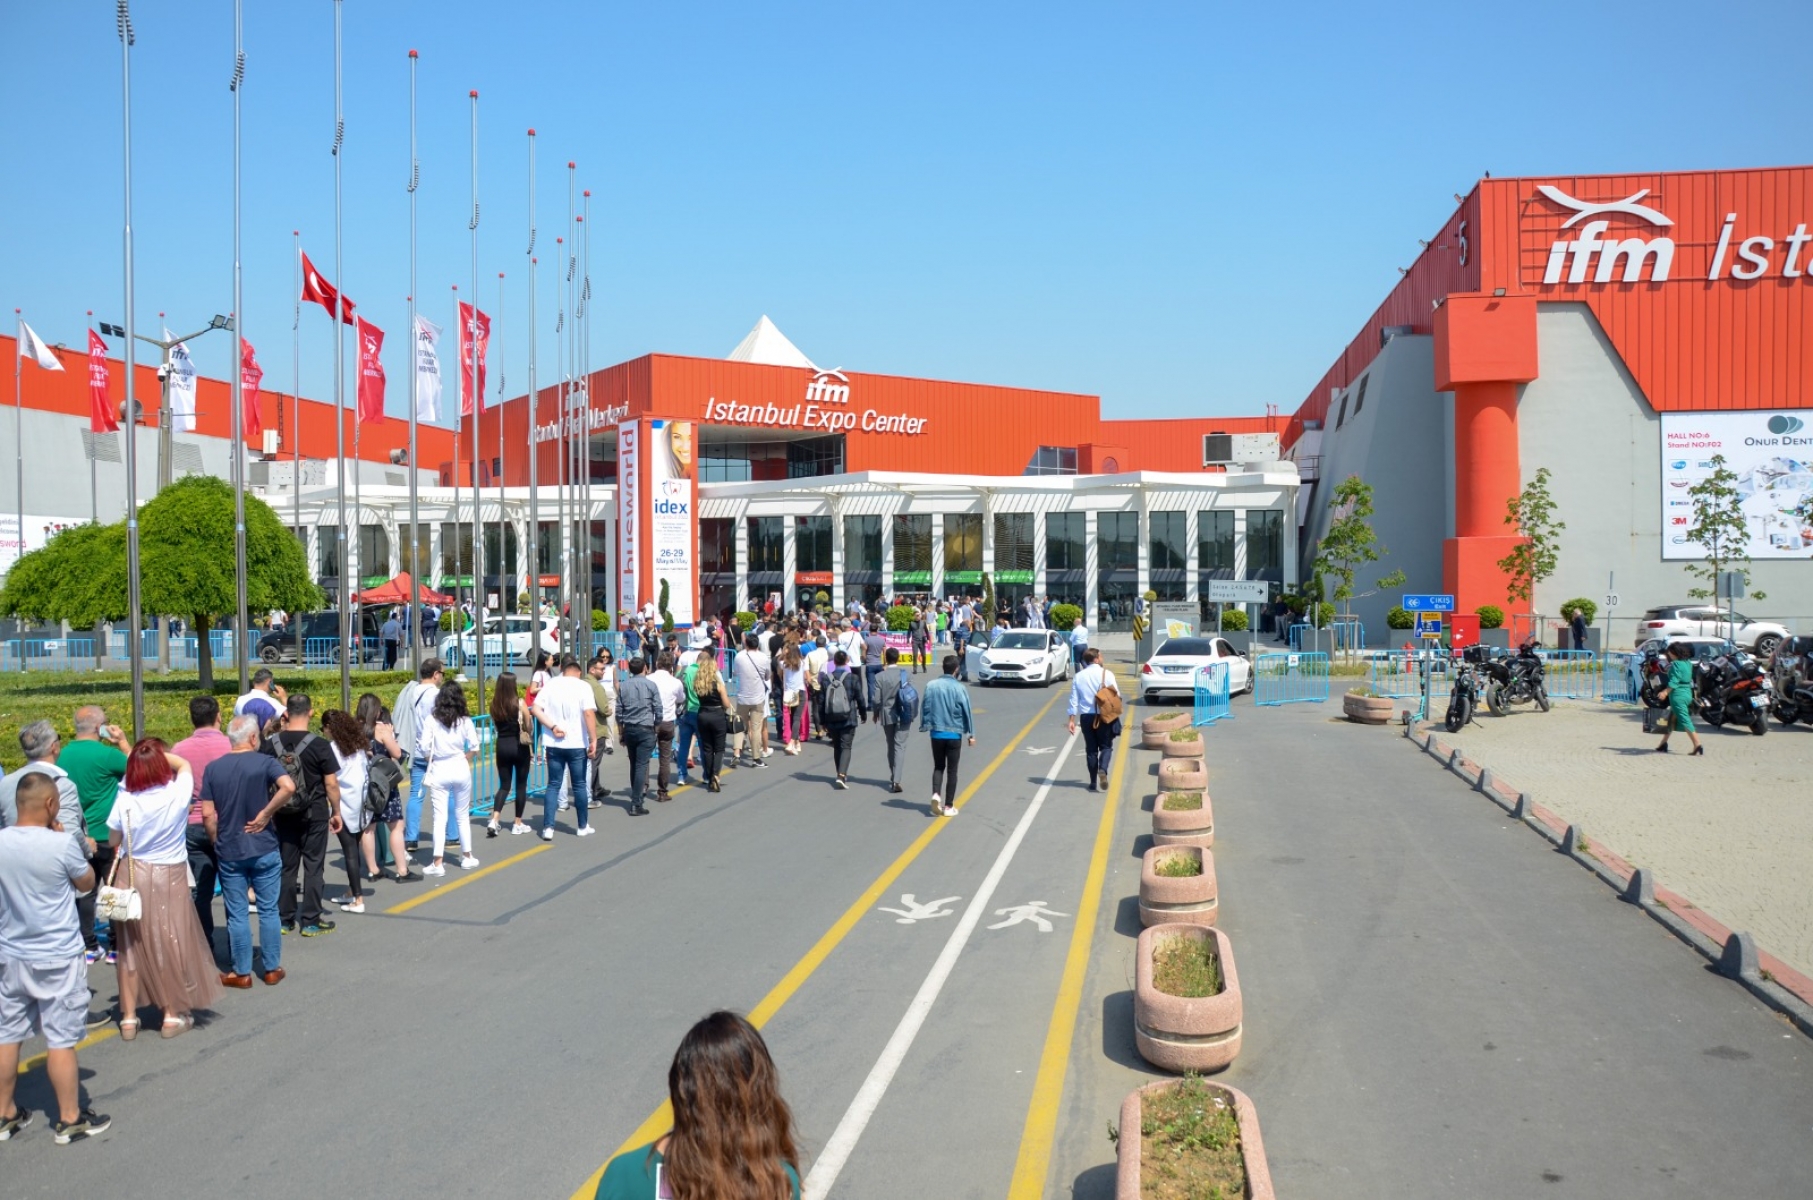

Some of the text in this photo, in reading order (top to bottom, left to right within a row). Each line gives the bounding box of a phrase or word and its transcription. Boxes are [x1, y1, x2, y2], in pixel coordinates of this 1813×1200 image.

[1459, 221, 1468, 268] 5
[1543, 212, 1813, 284] ifm İst
[805, 377, 850, 403] ifm
[803, 405, 857, 433] Expo
[861, 409, 927, 434] Center
[1744, 436, 1779, 446] ONUR
[655, 498, 688, 514] idex
[1671, 517, 1687, 526] 3M
[660, 549, 684, 557] 26-29
[1605, 595, 1618, 606] 30
